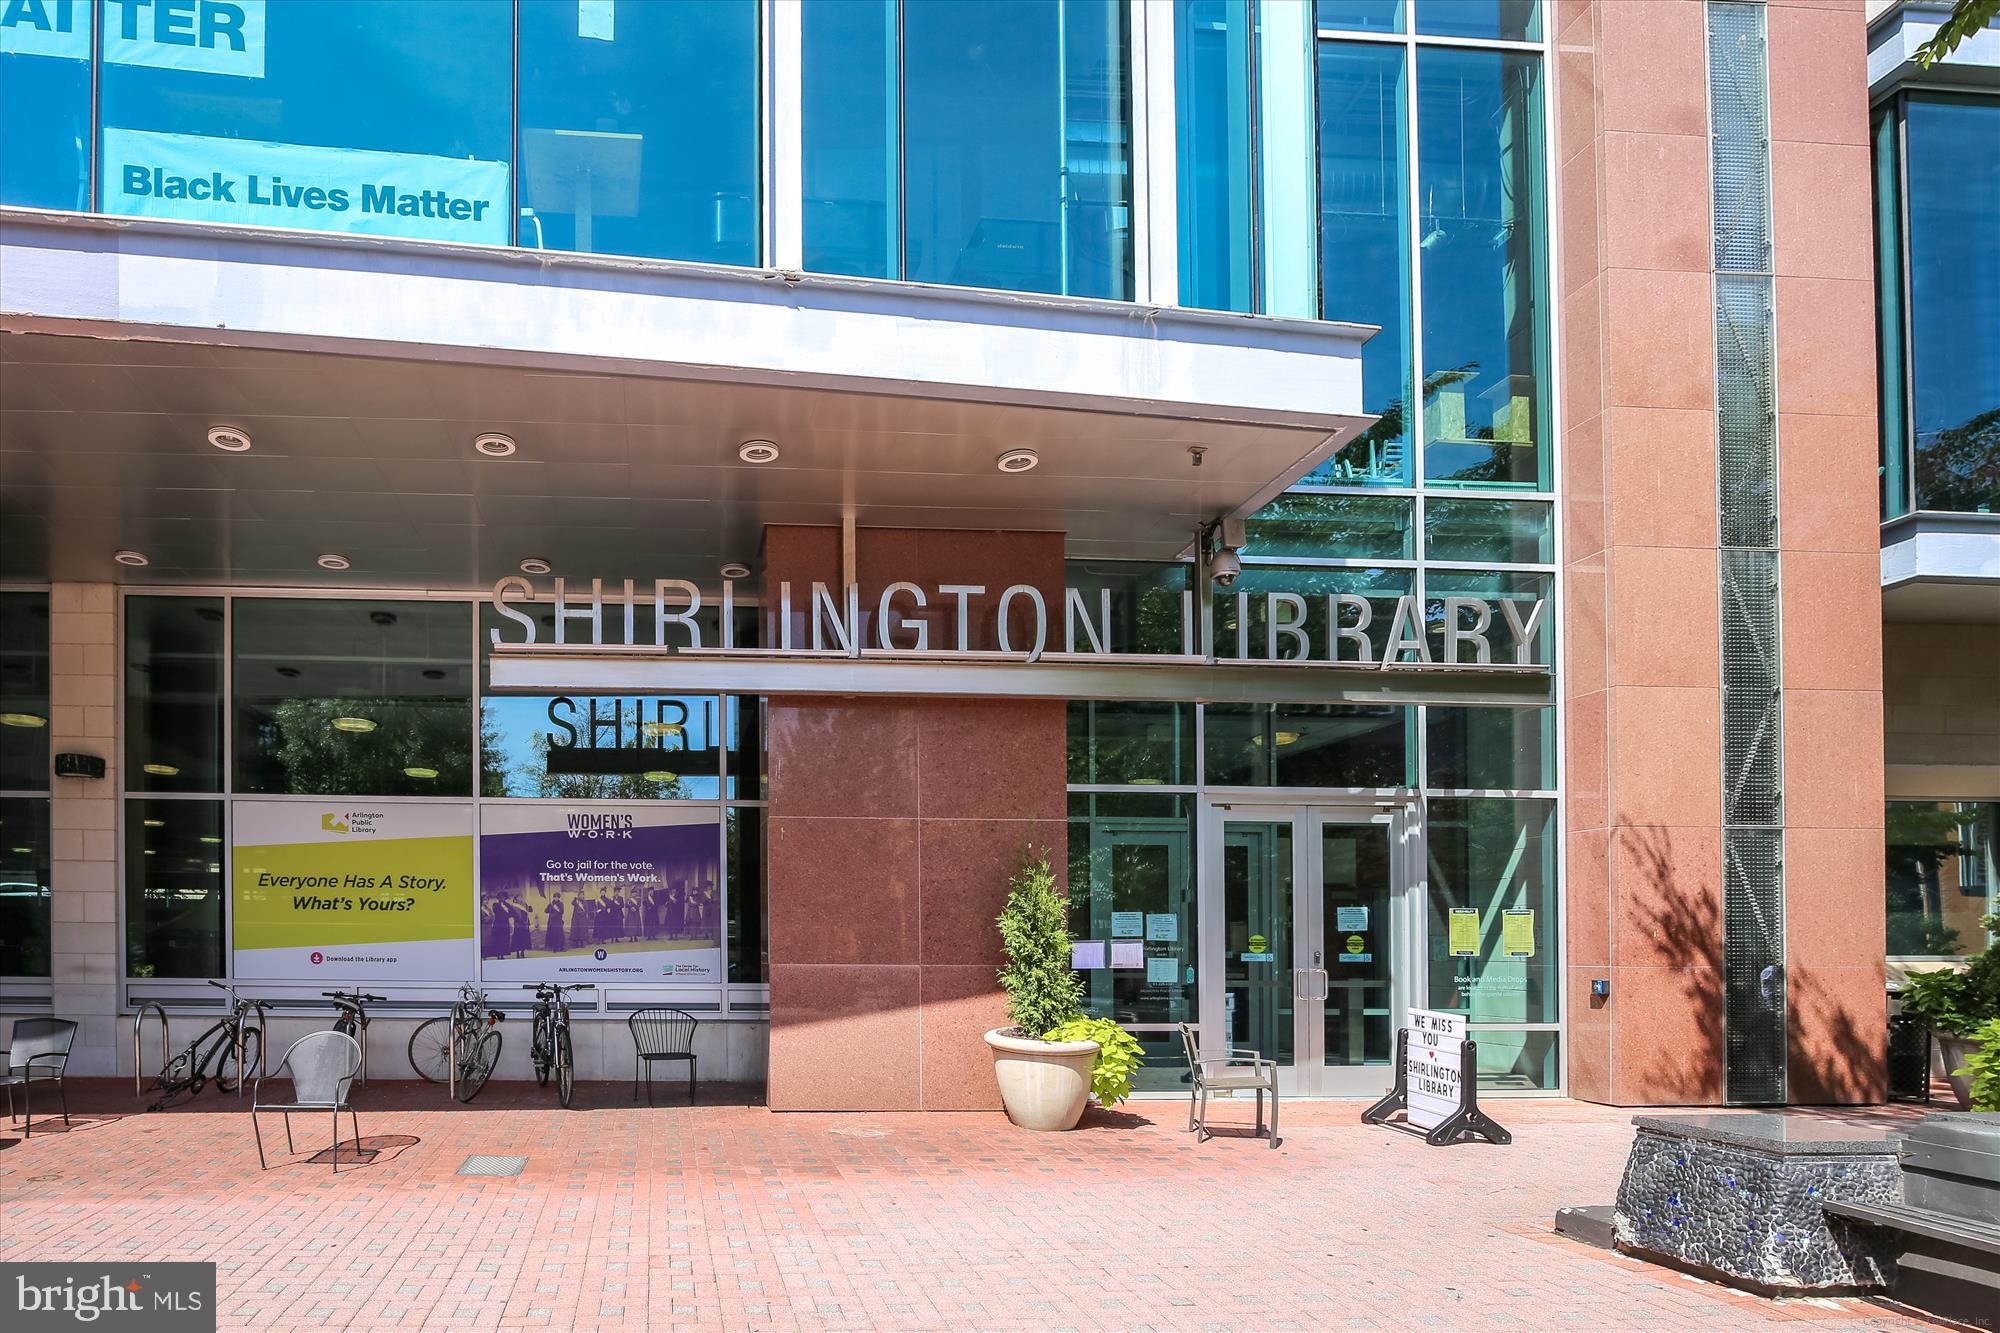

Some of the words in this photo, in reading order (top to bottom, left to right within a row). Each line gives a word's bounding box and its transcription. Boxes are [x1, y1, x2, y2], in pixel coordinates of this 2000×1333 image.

[122, 164, 236, 203] Black
[247, 174, 350, 212] Lives
[361, 183, 490, 222] Matter
[490, 575, 1112, 662] SHIRLINGTON
[1183, 590, 1545, 672] LIBRARY
[351, 811, 384, 820] Arlington
[567, 813, 633, 830] WOMEN'S
[351, 826, 377, 835] Library
[546, 859, 561, 870] Go
[563, 860, 575, 870] to
[576, 860, 592, 872] jail
[593, 860, 609, 870] for
[610, 860, 628, 870] the
[629, 861, 655, 870] vote.
[258, 873, 339, 890] Everyone
[343, 874, 376, 888] Has
[379, 875, 393, 888] A
[398, 875, 447, 892] Story.
[539, 872, 573, 882] That's
[575, 872, 625, 882] Women's
[627, 873, 661, 883] Work.
[292, 896, 353, 910] What's
[358, 897, 416, 911] Yours?
[1453, 975, 1471, 983] Book
[1414, 1014, 1426, 1029] WE
[1431, 1017, 1453, 1033] MISS
[1422, 1031, 1439, 1047] YOU
[1408, 1059, 1462, 1084] SHIRLINGTON
[1418, 1078, 1454, 1098] LIBRARY
